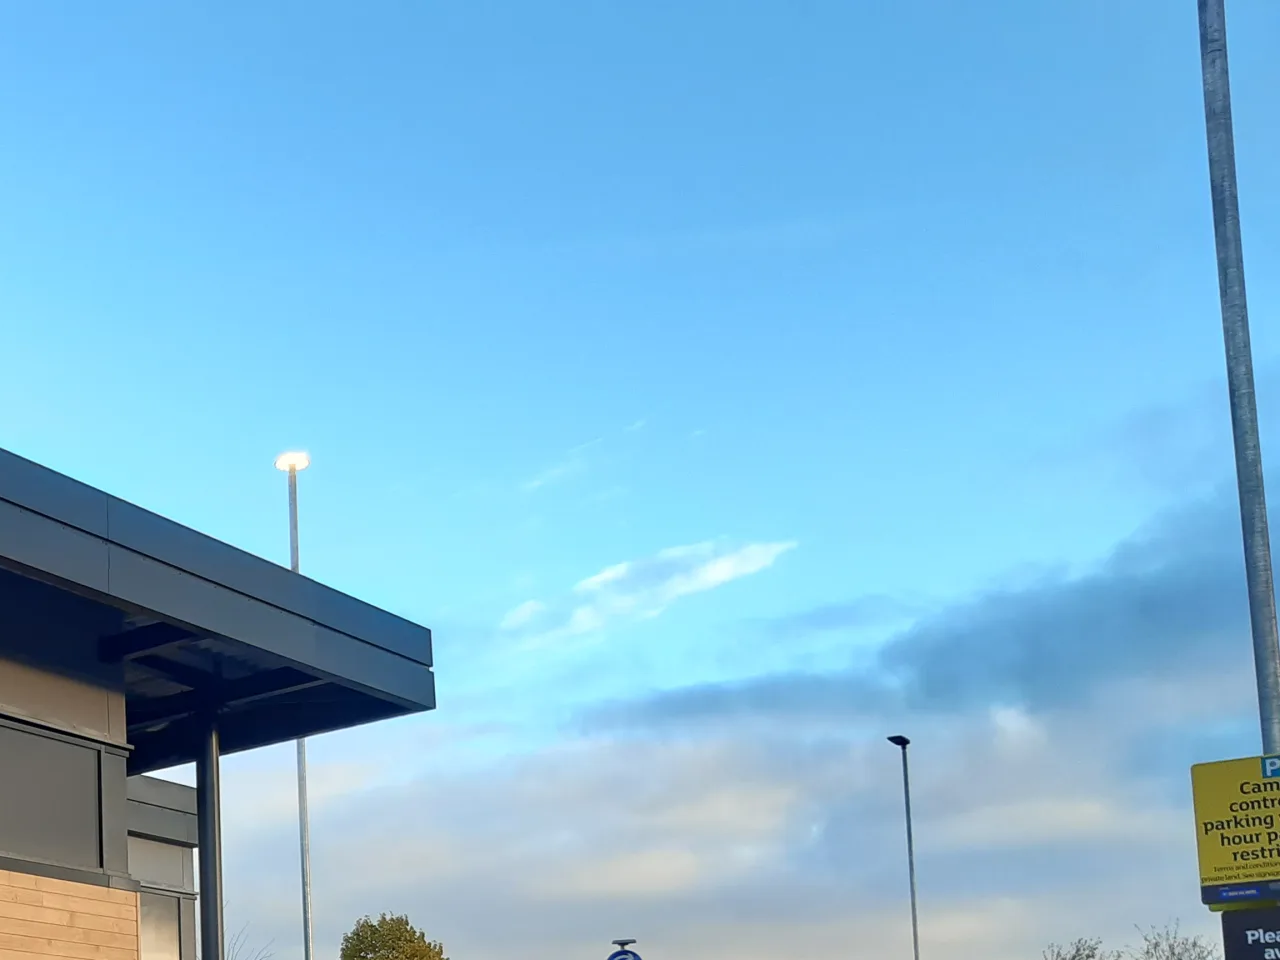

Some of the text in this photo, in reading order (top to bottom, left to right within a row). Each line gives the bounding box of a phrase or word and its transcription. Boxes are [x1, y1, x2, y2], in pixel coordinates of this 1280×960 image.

[1229, 796, 1280, 812] contr
[1203, 814, 1274, 836] parking
[1220, 832, 1261, 847] hour
